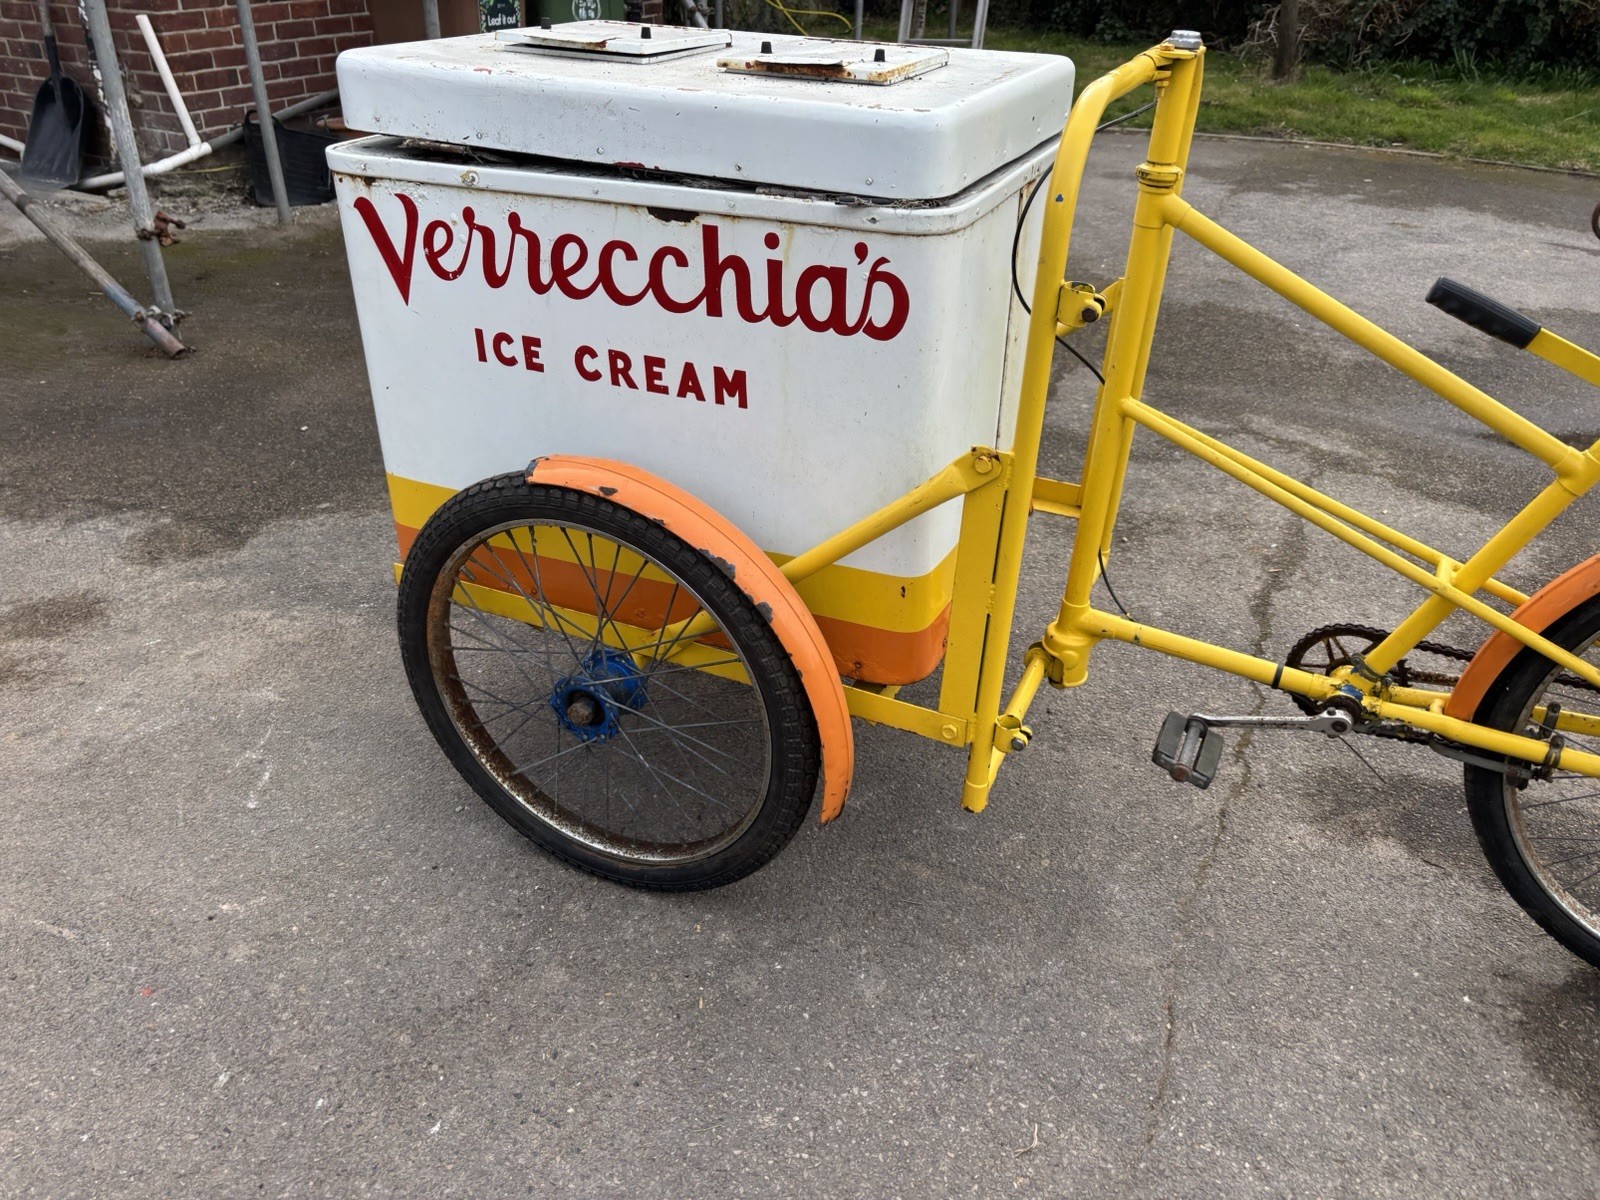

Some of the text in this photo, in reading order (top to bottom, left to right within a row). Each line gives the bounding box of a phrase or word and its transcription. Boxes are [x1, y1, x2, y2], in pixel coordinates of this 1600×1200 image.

[487, 13, 502, 26] Leaf
[354, 193, 909, 340] Verrecchia's
[475, 329, 747, 408] ICE CREAM
